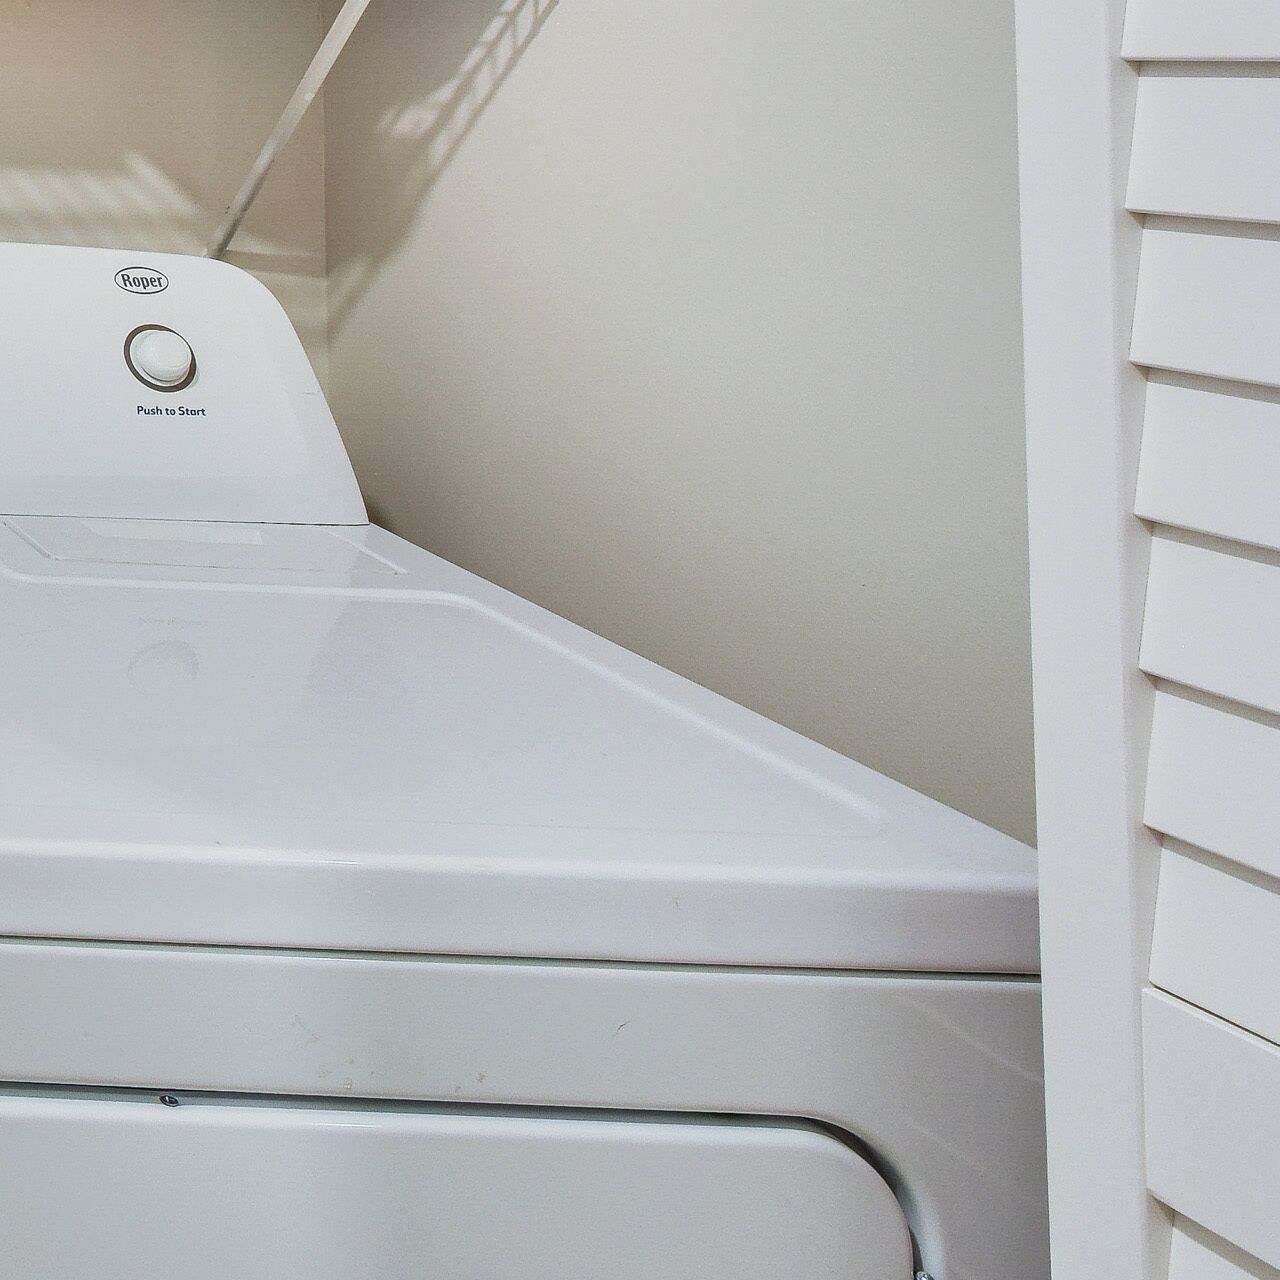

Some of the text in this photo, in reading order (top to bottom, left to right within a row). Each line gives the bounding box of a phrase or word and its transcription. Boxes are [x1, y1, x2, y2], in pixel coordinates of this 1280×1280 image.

[120, 273, 163, 290] Roper
[137, 405, 206, 417] Push to Start
